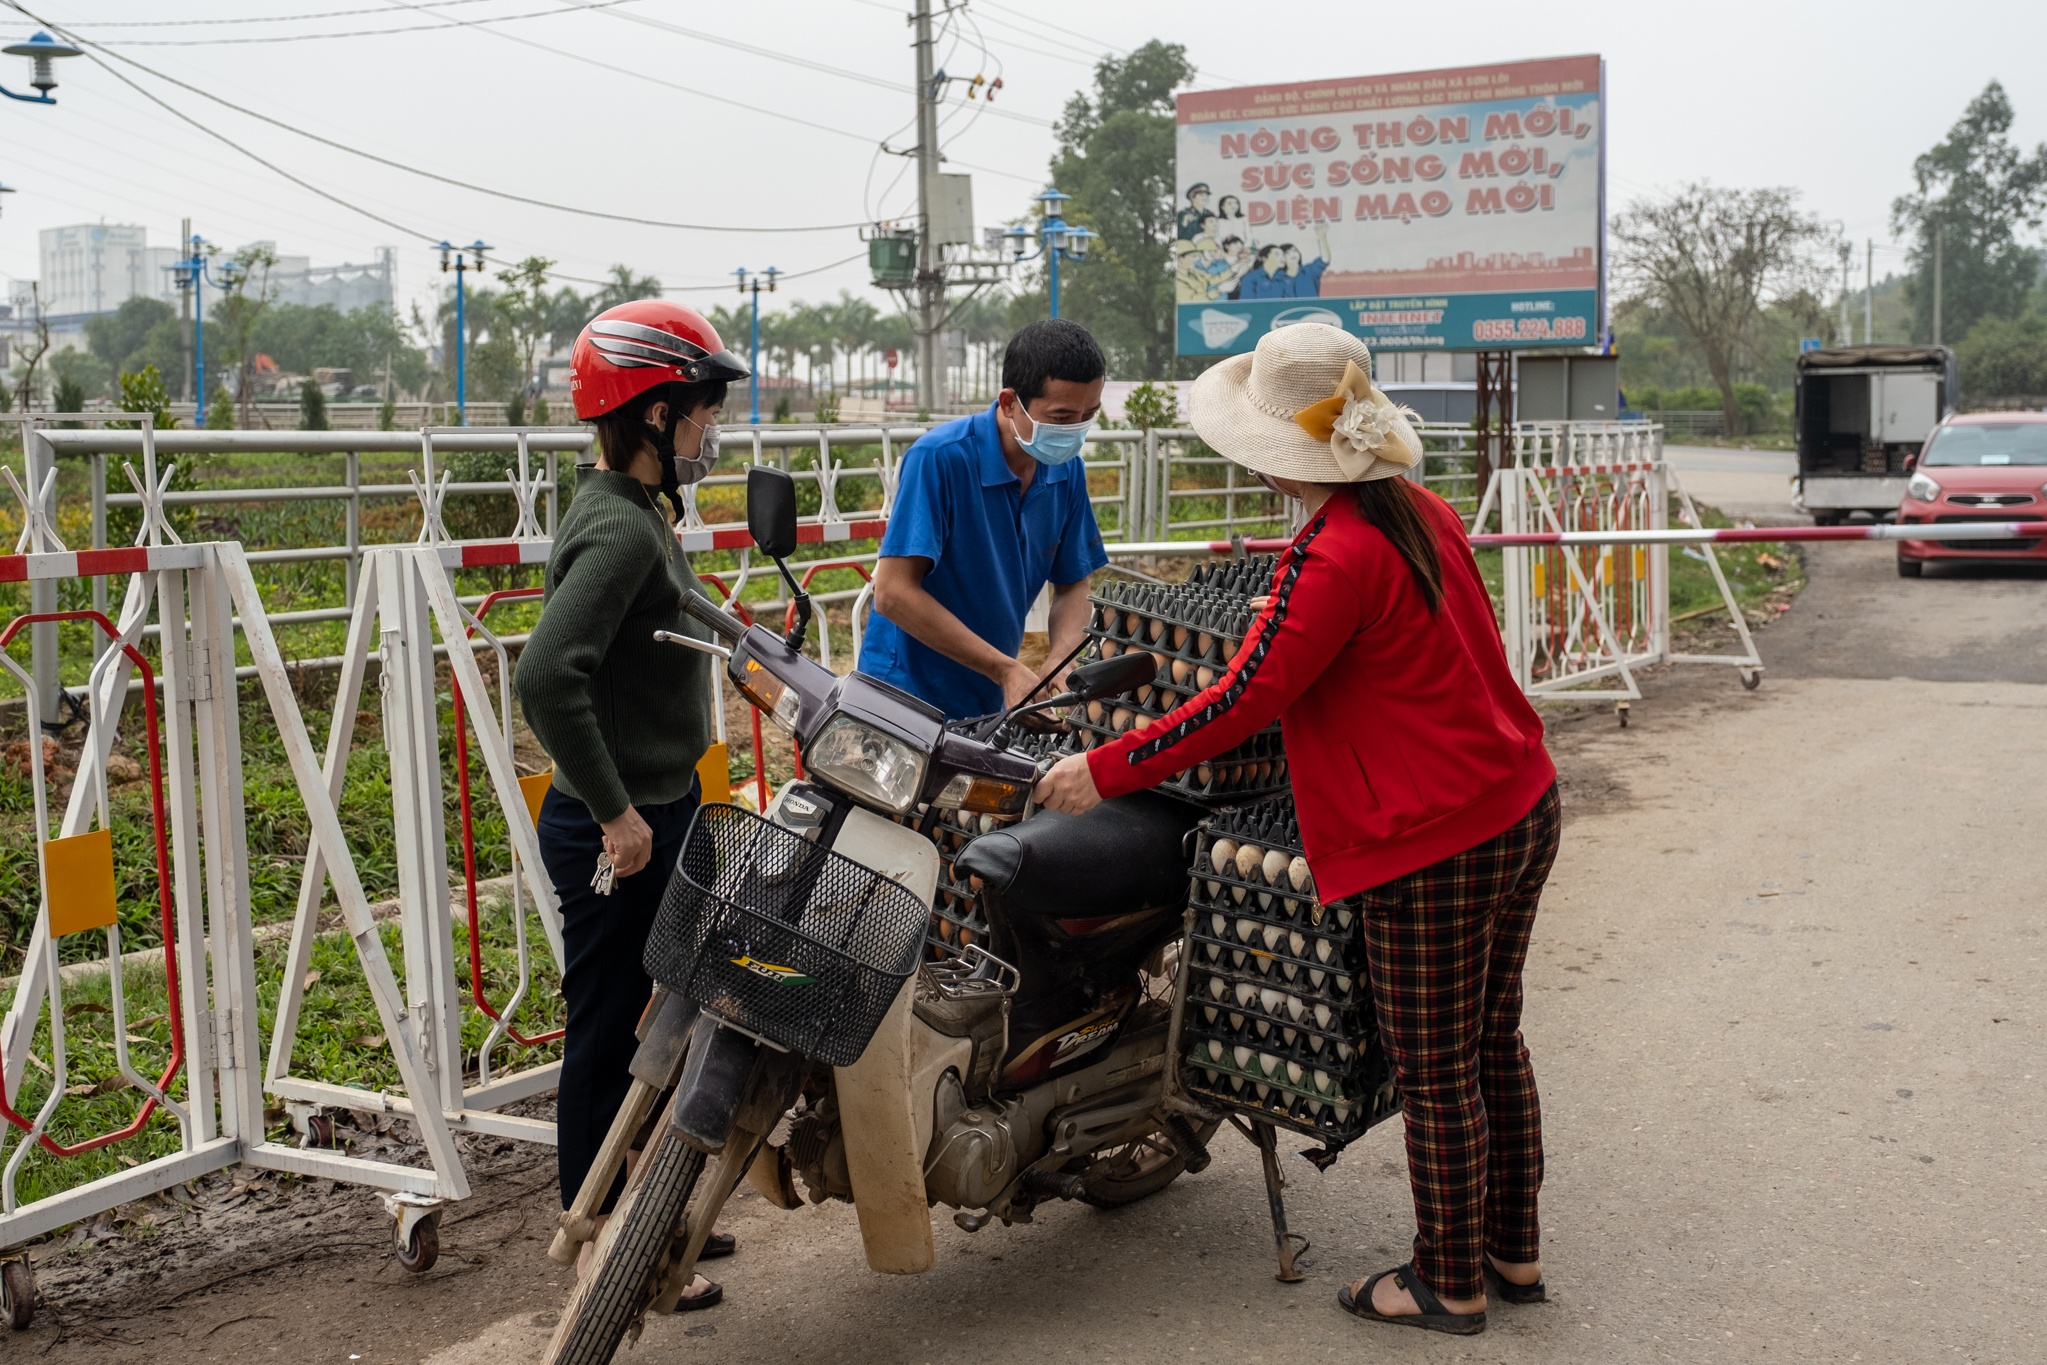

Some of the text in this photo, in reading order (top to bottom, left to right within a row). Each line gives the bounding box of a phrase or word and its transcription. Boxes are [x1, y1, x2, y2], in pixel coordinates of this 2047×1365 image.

[1220, 103, 1591, 158] NÔNG THÔN MỚI,
[1241, 143, 1565, 191] SỨC SỐNG MỚI,
[1248, 179, 1555, 230] DIỆN MẠO MỚI
[1359, 309, 1444, 326] INTERNET
[1511, 301, 1555, 312] HOTLINE:
[1473, 317, 1586, 341] 0355.224.888
[785, 797, 809, 811] HONDA
